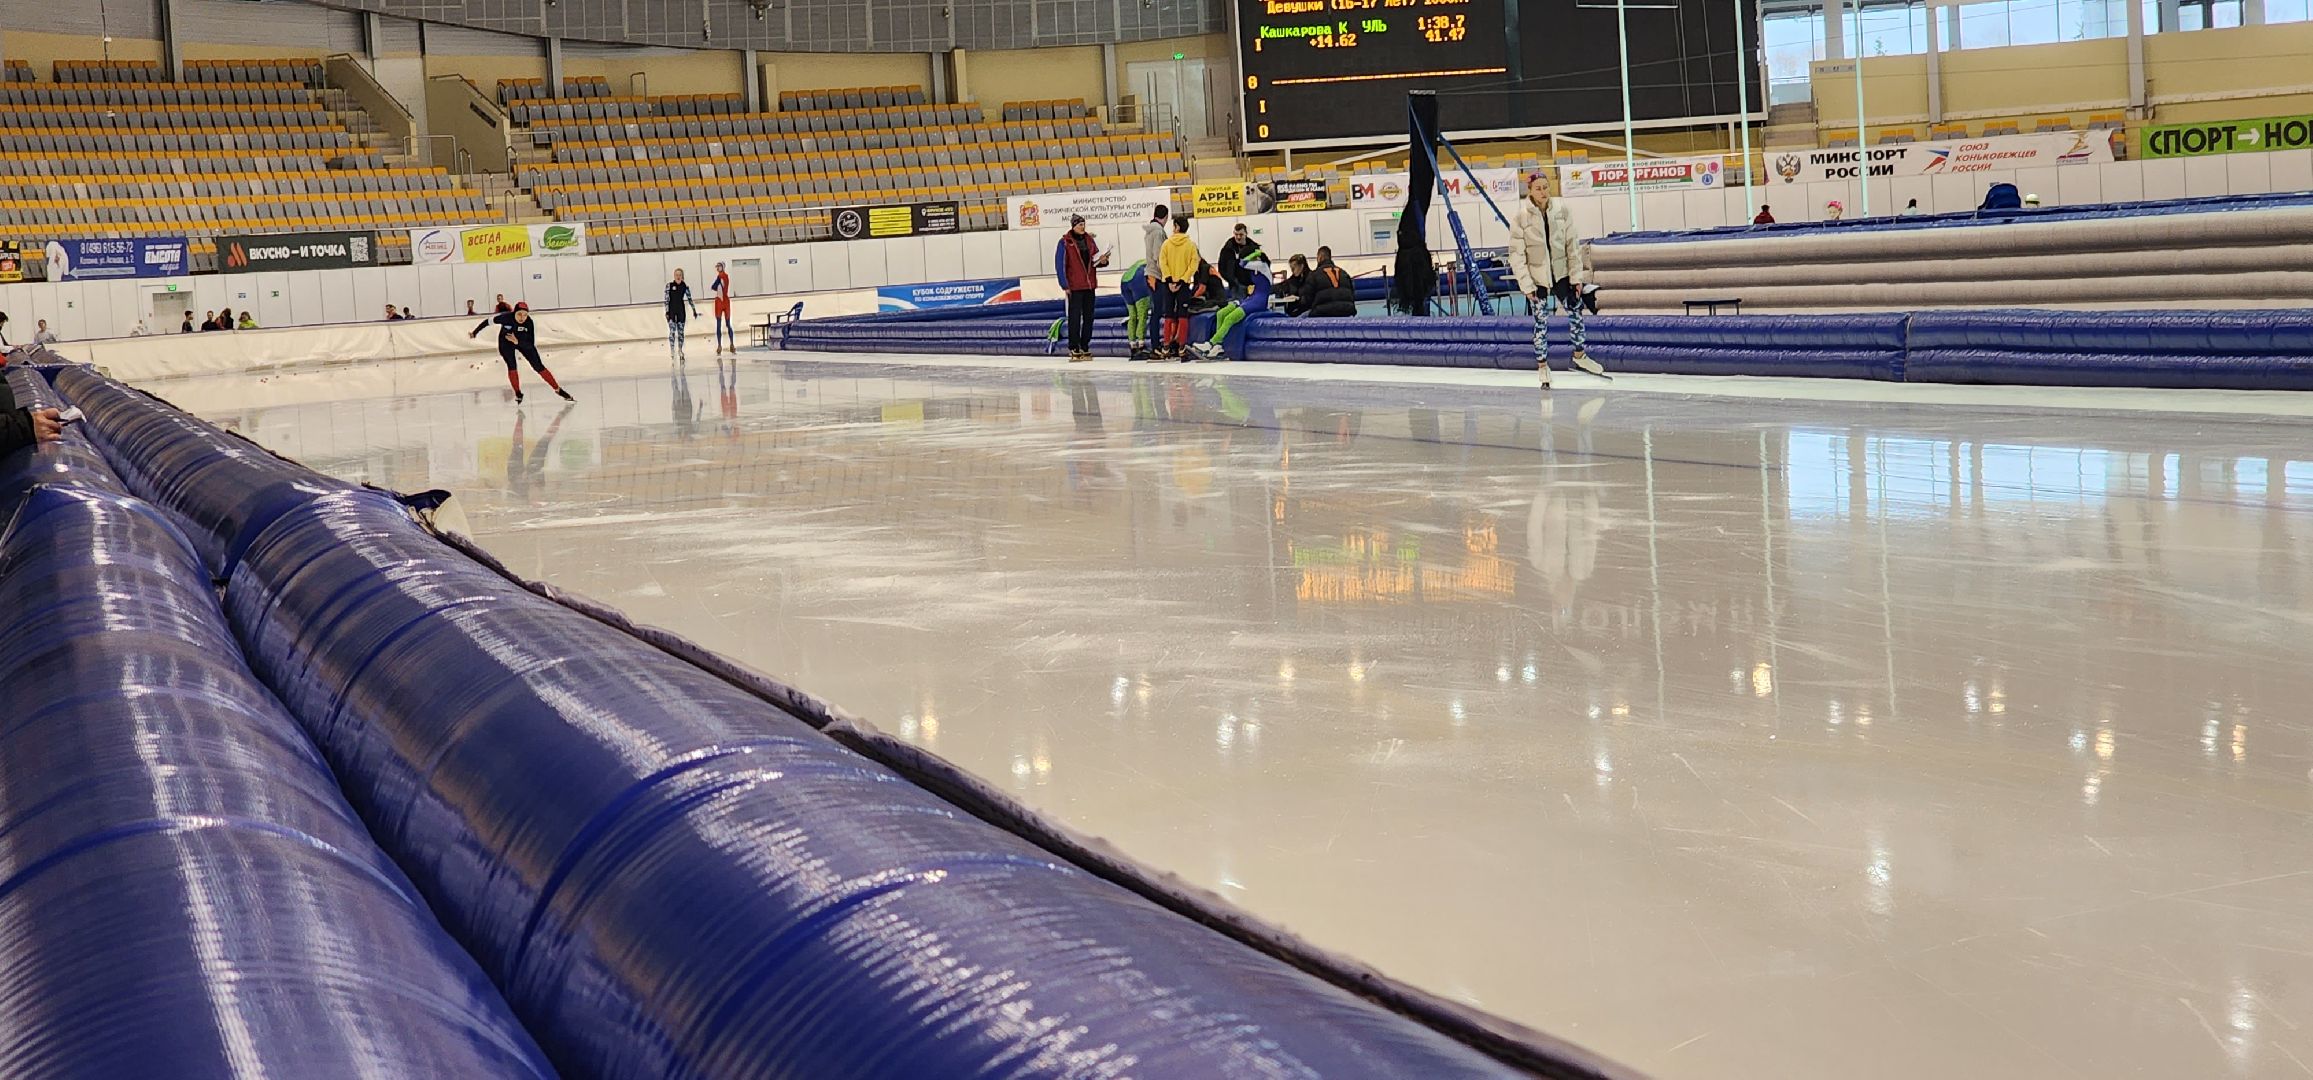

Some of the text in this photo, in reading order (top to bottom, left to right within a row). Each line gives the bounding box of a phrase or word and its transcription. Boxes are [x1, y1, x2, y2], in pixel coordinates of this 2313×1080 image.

[1267, 1, 1324, 14] Девушки
[1260, 15, 1465, 38] Кашкарова К УЛЬ 1:38.7
[1309, 33, 1358, 48] +14.62
[1425, 27, 1466, 42] 41.47
[2149, 125, 2237, 155] СПОРТ
[1959, 143, 1990, 152] СОЮЗ
[1955, 150, 2038, 162] КОНЬКОБЕЖЦЕВ
[1951, 163, 1993, 172] РОССИИ
[1597, 166, 1687, 182] ЛОР-РГАНОВ
[1072, 195, 1127, 205] МИНИСТЕРСТВО
[1199, 191, 1240, 202] APPLE
[1043, 206, 1089, 215] ФИЗИЧЕСКОЙ
[1090, 204, 1125, 213] КУЛЬТУРЫ
[1109, 211, 1141, 219] ОБЛАСТИ
[1197, 205, 1243, 214] PINEAPPLE
[467, 231, 501, 246] ВСЕГДА
[249, 246, 290, 260] ВКУСНО
[300, 246, 309, 258] И
[310, 244, 347, 258] ТОЧКА
[487, 241, 526, 257] С ВАМИ!
[912, 285, 985, 296] КУБОК СОДРУЖЕСТВА
